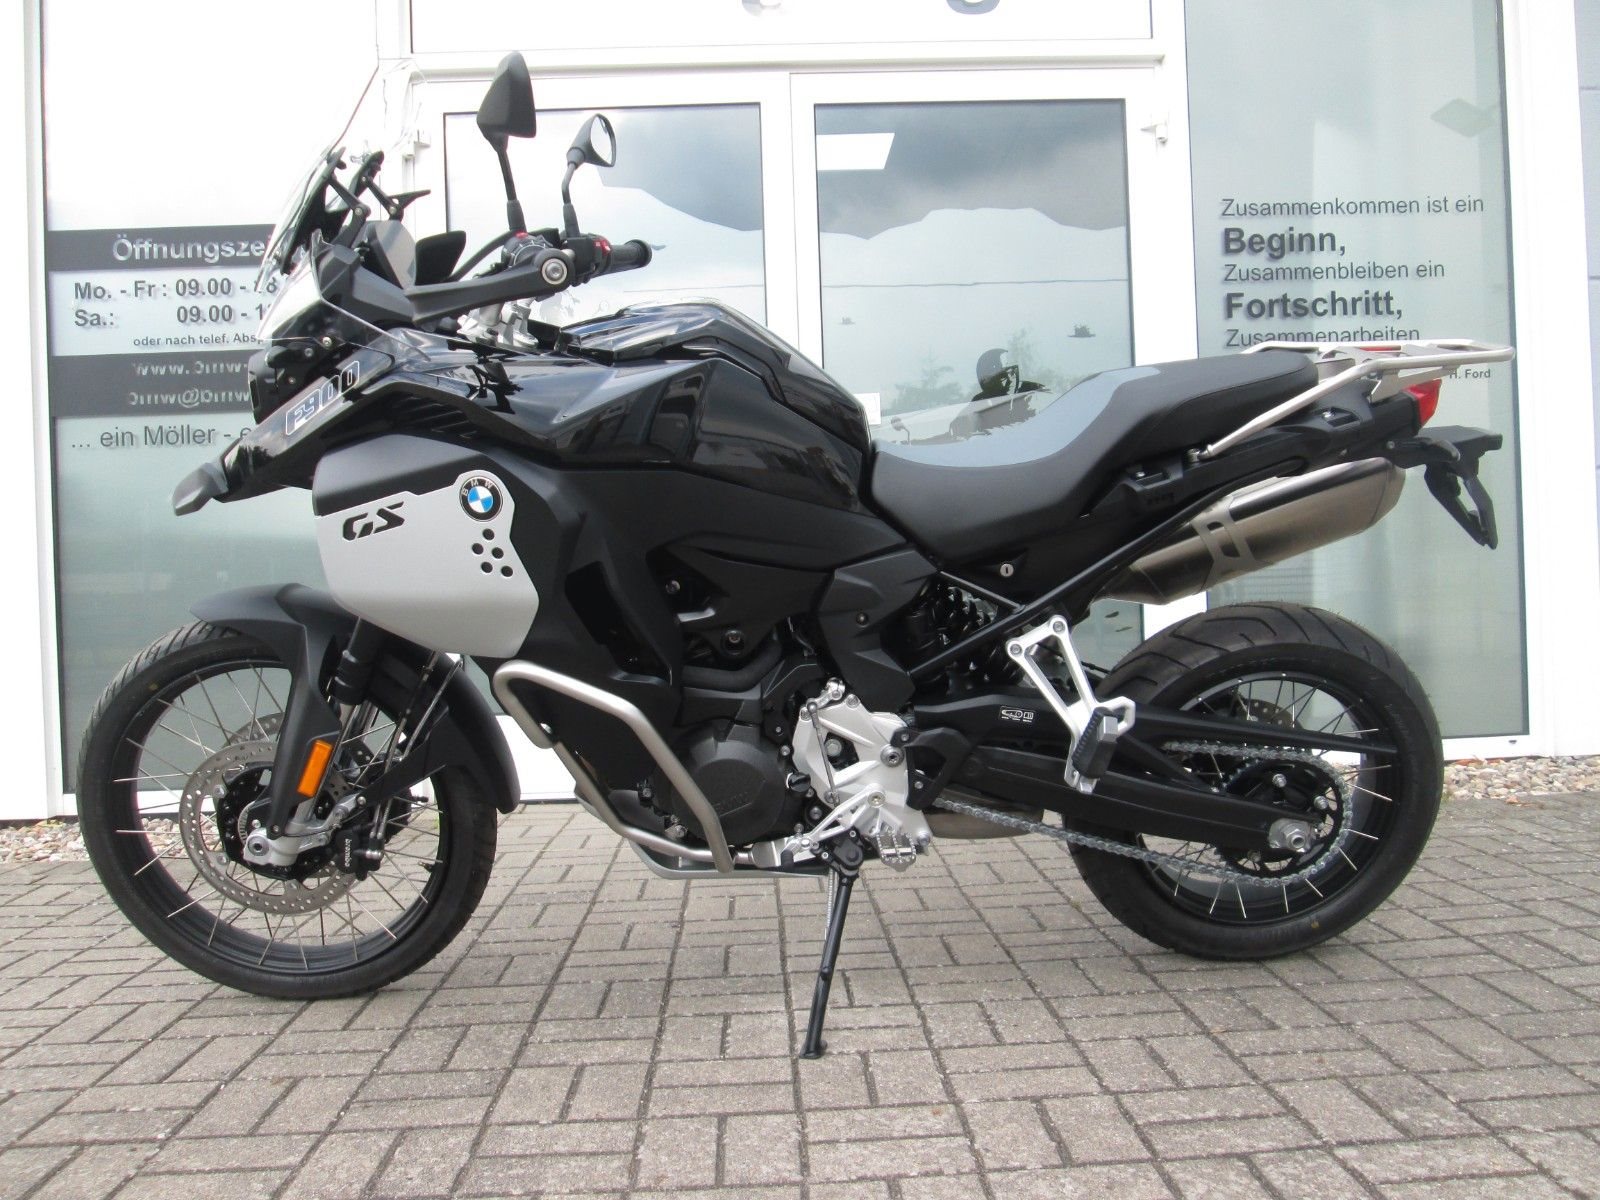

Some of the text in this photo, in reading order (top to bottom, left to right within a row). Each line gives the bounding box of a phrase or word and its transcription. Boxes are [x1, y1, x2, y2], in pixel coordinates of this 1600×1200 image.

[1221, 195, 1484, 216] Zusammenkommen ist ein
[112, 233, 269, 264] Öffnungsze
[1223, 226, 1346, 260] Beginn,
[1224, 260, 1445, 282] Zusammenbleiben ein
[74, 281, 112, 300] Mo.
[175, 277, 232, 297] 09.00
[74, 309, 114, 327] Sa.:
[176, 304, 233, 323] 09.00
[1226, 290, 1402, 319] Fortschritt,
[133, 335, 162, 346] oder
[166, 334, 195, 345] nach
[199, 333, 230, 345] telef.
[1226, 325, 1420, 347] Zusammenarbeiten
[1465, 368, 1491, 379] Ford
[100, 426, 134, 447] ein
[144, 424, 215, 446] Möller
[461, 478, 494, 497] BMW
[342, 500, 405, 541] GS
[344, 838, 353, 868] brembo
